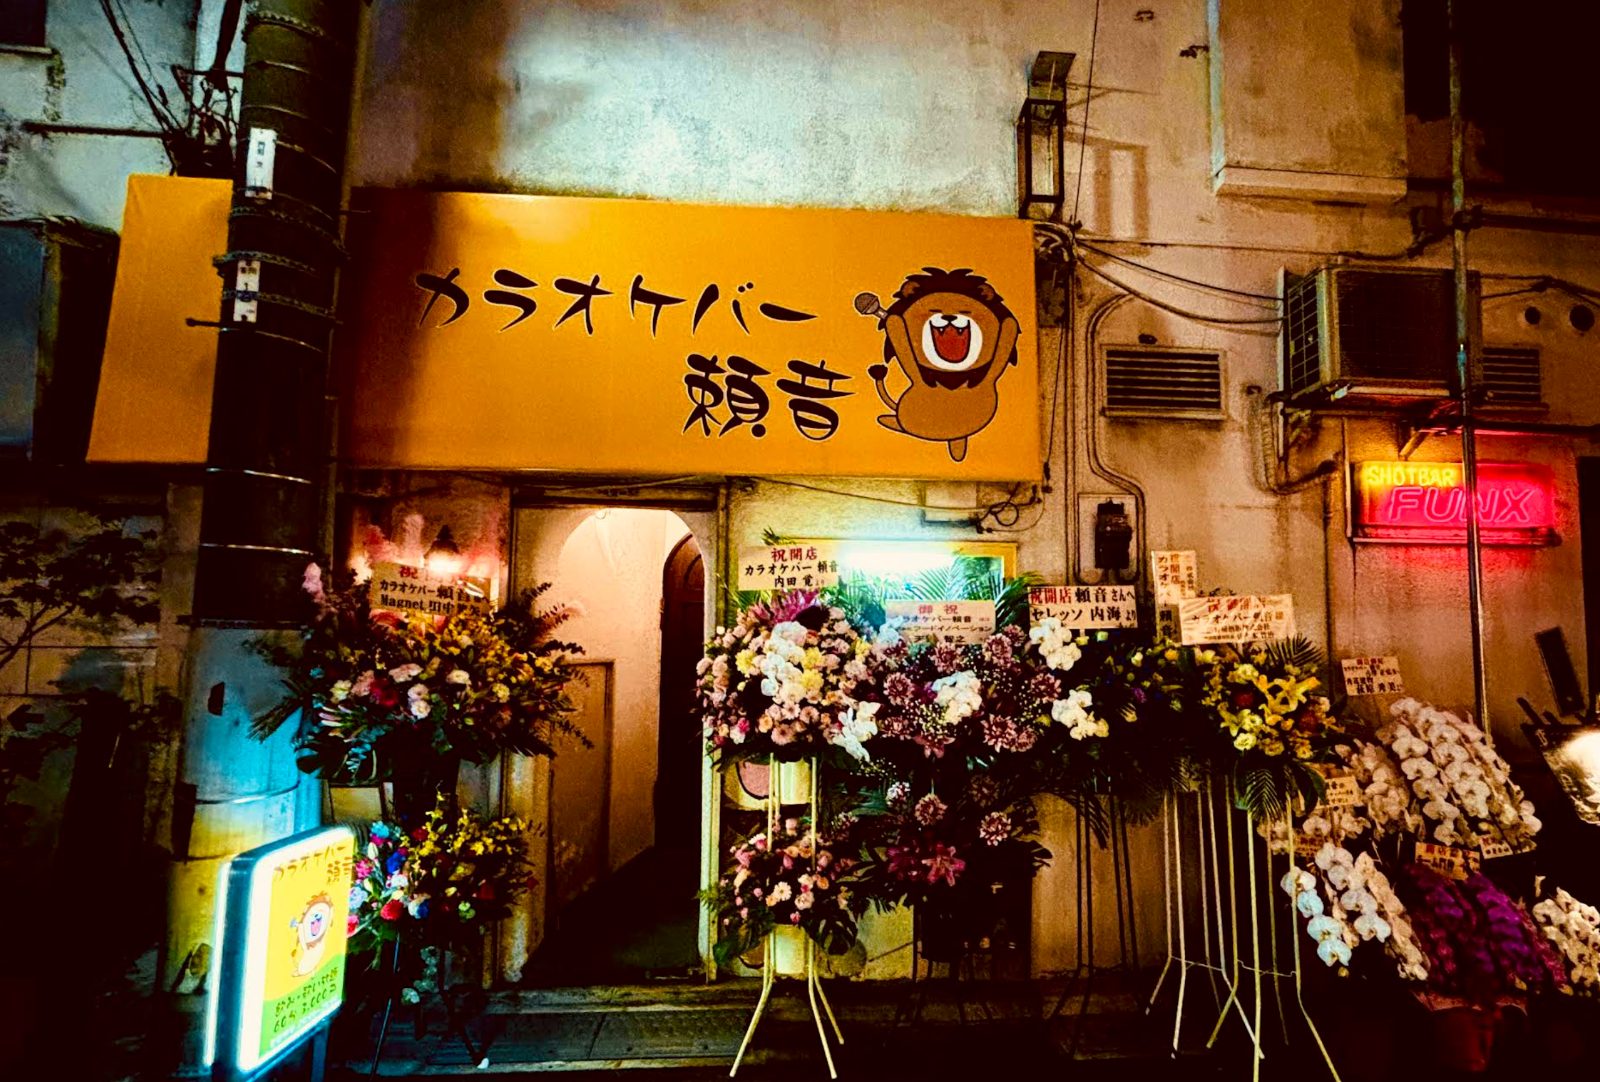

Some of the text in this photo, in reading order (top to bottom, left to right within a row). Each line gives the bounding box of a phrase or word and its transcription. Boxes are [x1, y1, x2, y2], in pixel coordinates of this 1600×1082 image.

[415, 267, 818, 337] カラオケバー
[682, 353, 856, 441] 頼音
[1367, 466, 1456, 486] SHOTBAR
[771, 547, 817, 562] 祝開店
[745, 563, 812, 576] カラオケバー
[380, 579, 437, 594] カラオケバー
[774, 575, 797, 587] 内田
[380, 594, 425, 610] Magnet
[1030, 587, 1071, 604] 祝開店
[1032, 607, 1083, 621] セレッソ
